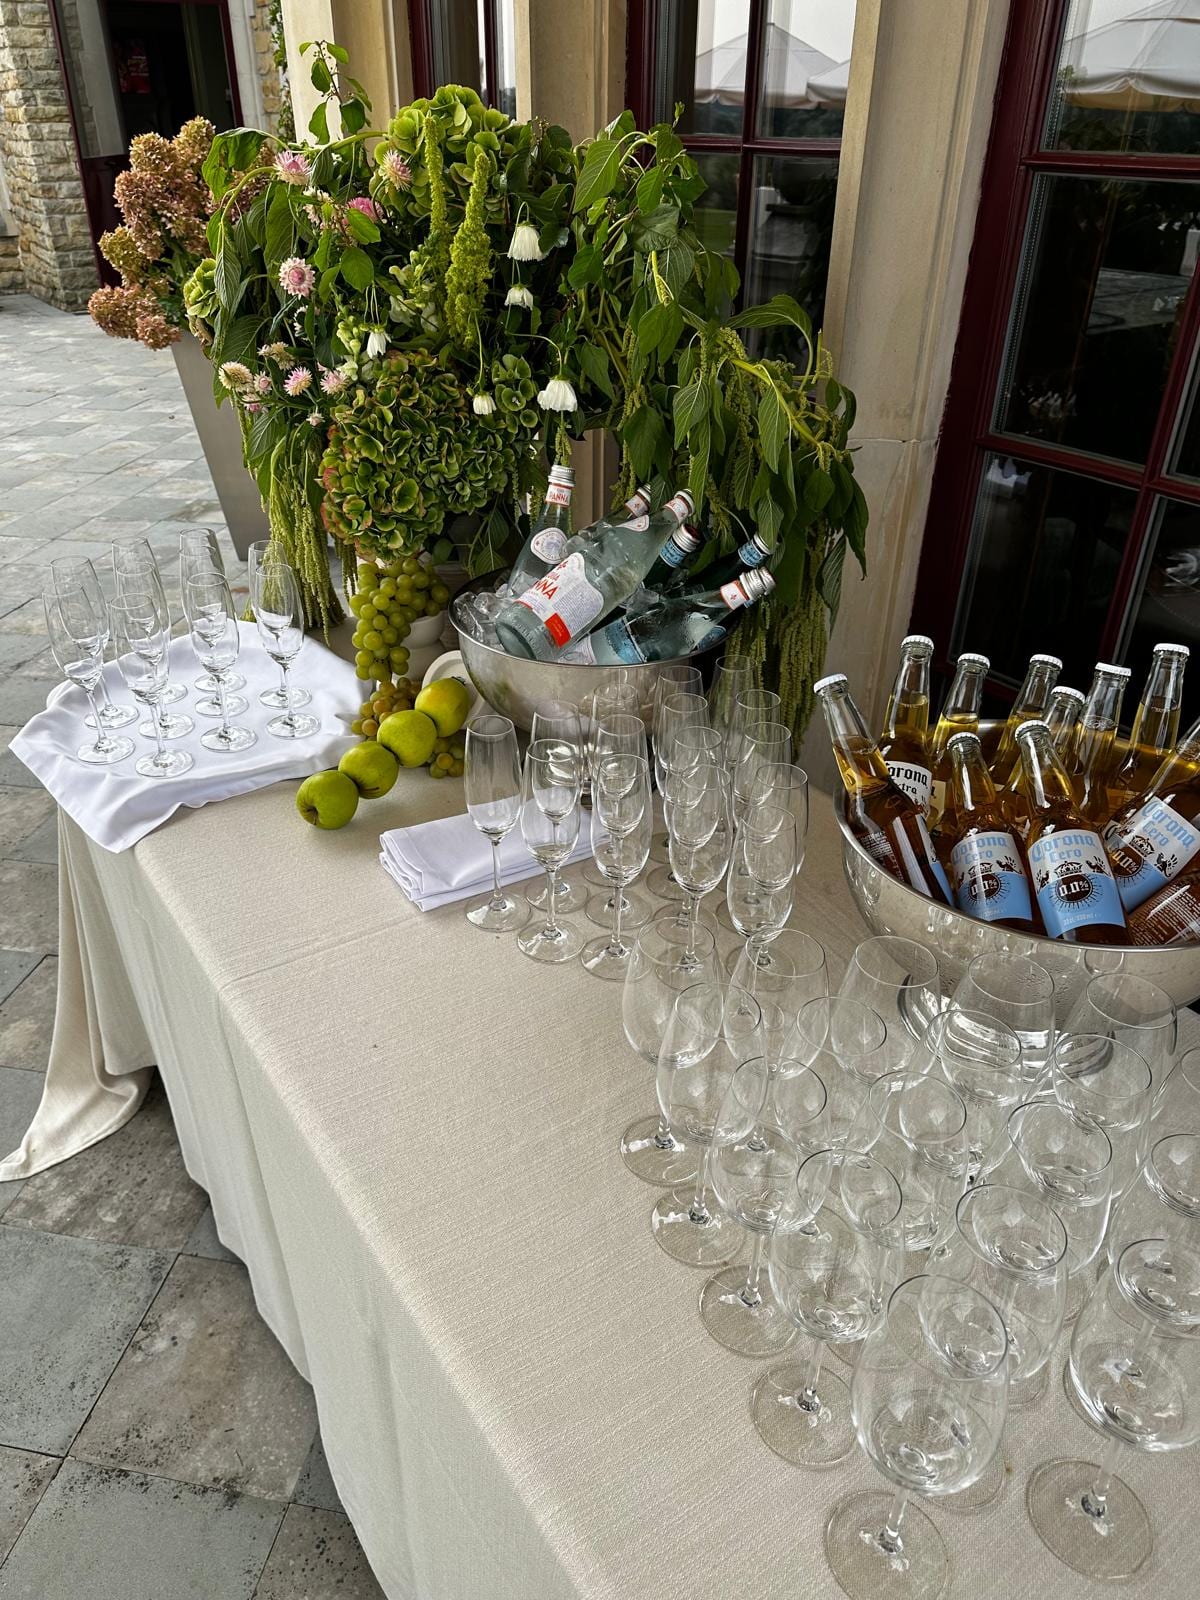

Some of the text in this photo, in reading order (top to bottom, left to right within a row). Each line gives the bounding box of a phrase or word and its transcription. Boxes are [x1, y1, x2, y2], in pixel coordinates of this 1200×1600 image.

[886, 762, 928, 787] orona
[899, 783, 917, 794] tra
[1141, 801, 1196, 849] Corona
[952, 836, 1008, 865] Corona
[1031, 834, 1096, 863] Corona
[1049, 848, 1082, 863] Cero
[971, 879, 998, 896] 00%
[1058, 880, 1089, 897] 0.0%
